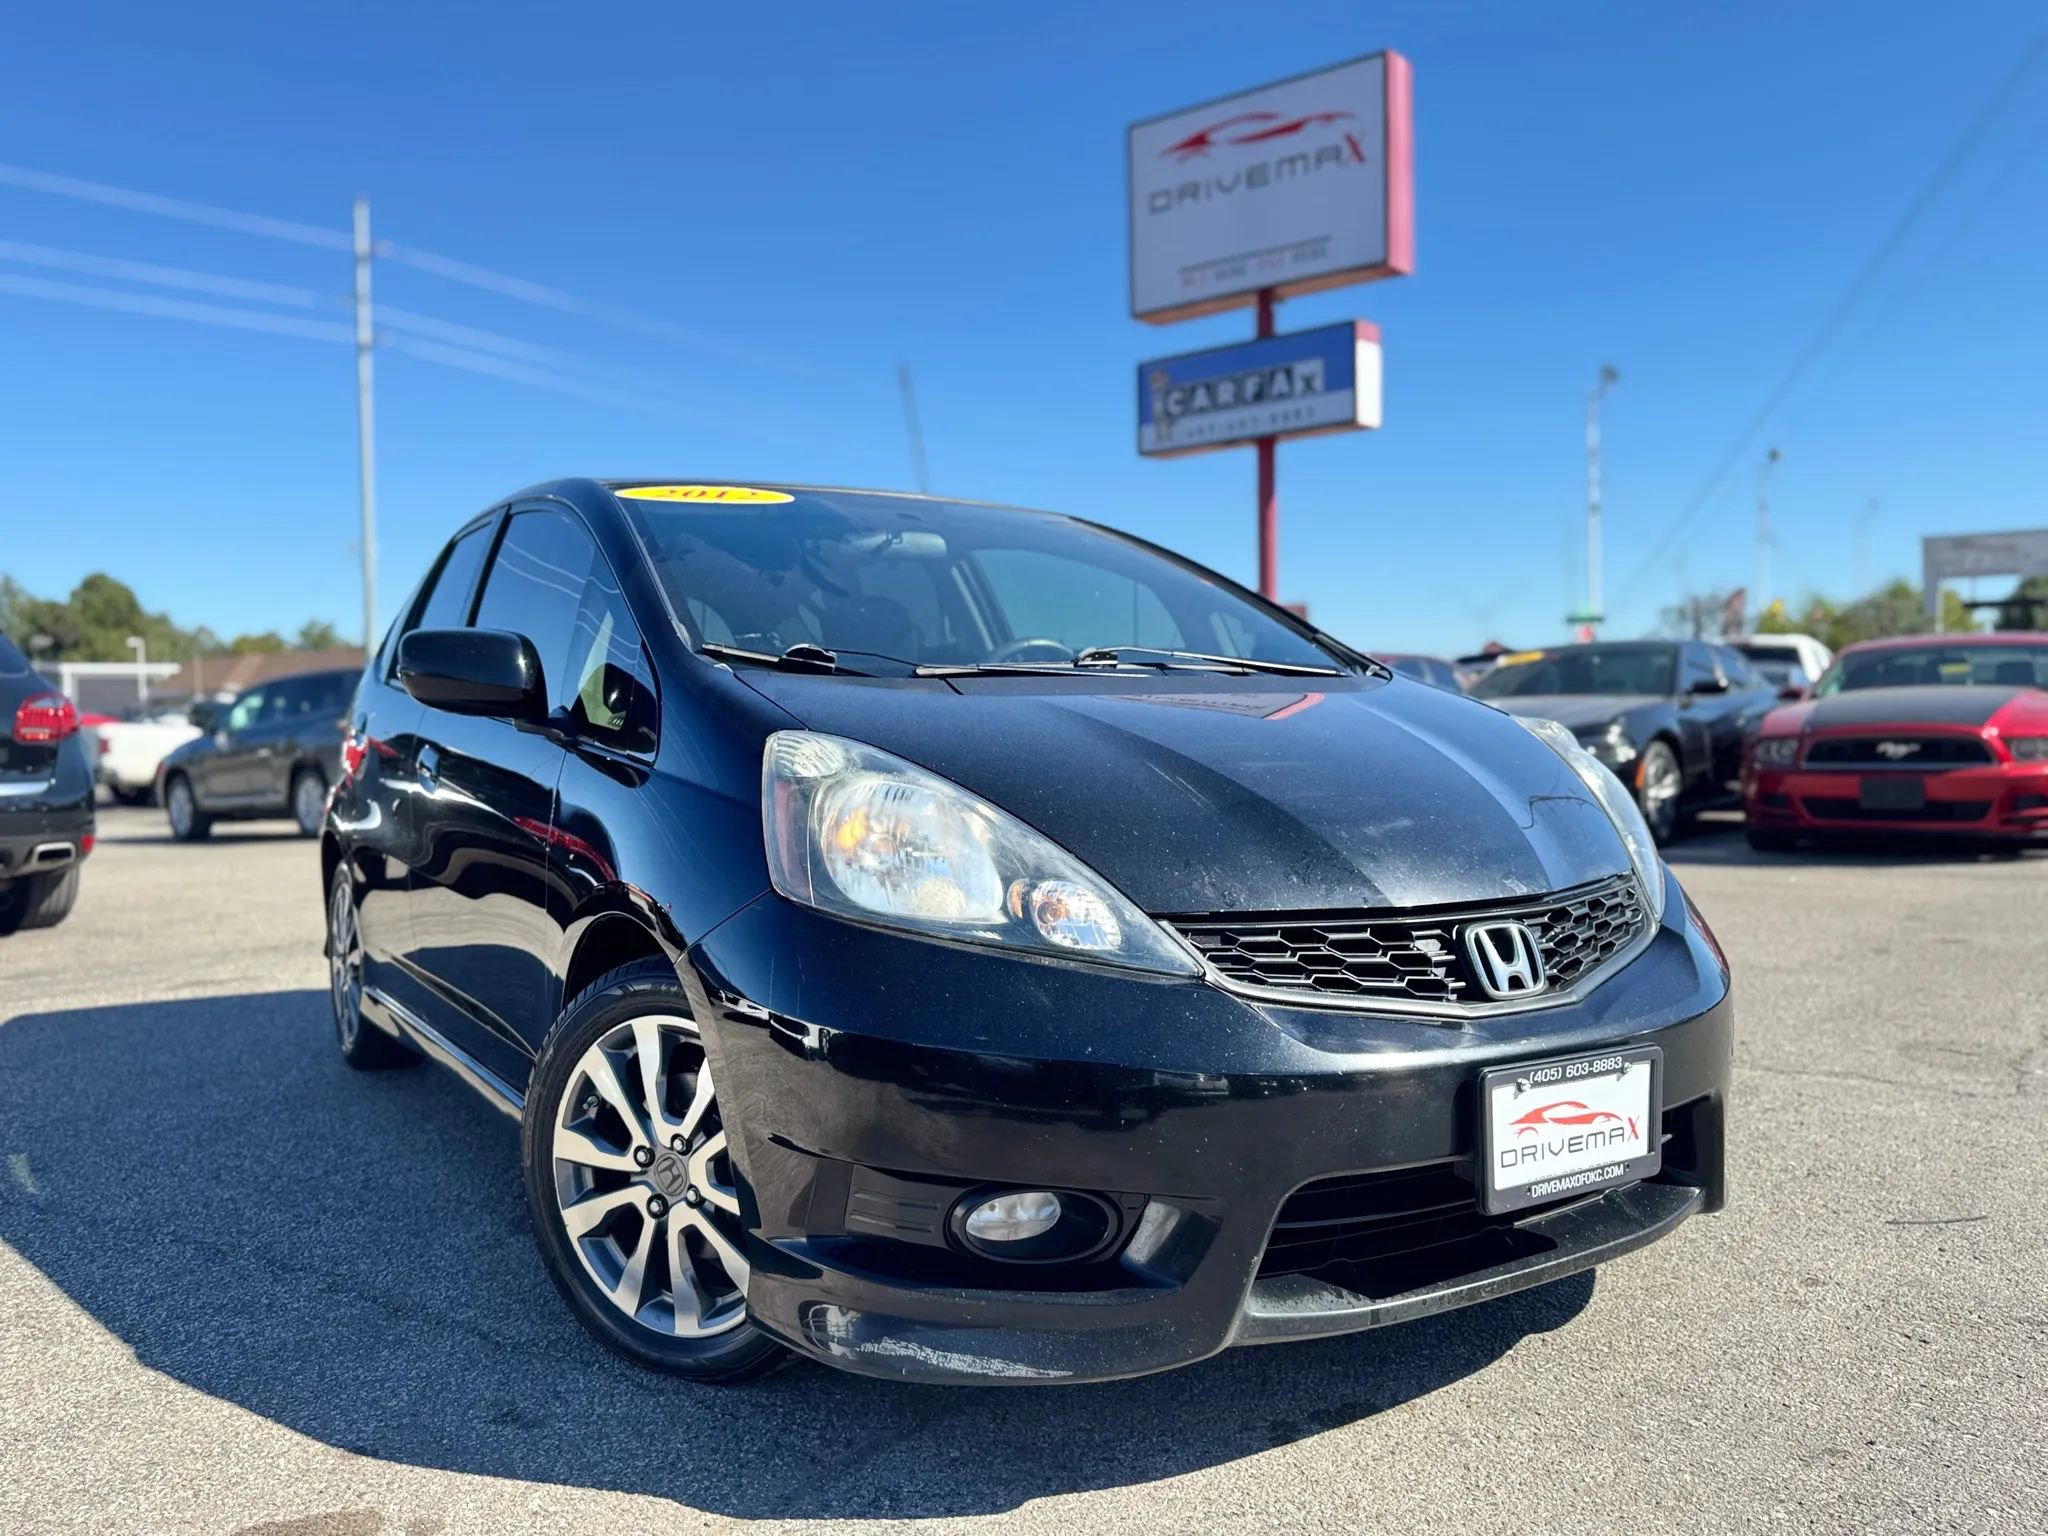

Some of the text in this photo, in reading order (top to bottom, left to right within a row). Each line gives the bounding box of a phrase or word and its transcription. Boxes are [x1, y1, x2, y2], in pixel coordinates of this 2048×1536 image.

[1147, 131, 1367, 216] DRIVEMAX
[1166, 363, 1319, 416] CARFAX
[1529, 1056, 1623, 1084] (405) 603-8883
[1501, 1115, 1639, 1168] DRIVEMAX
[1531, 1163, 1624, 1198] DRIVEMAXOFOKC.COM
